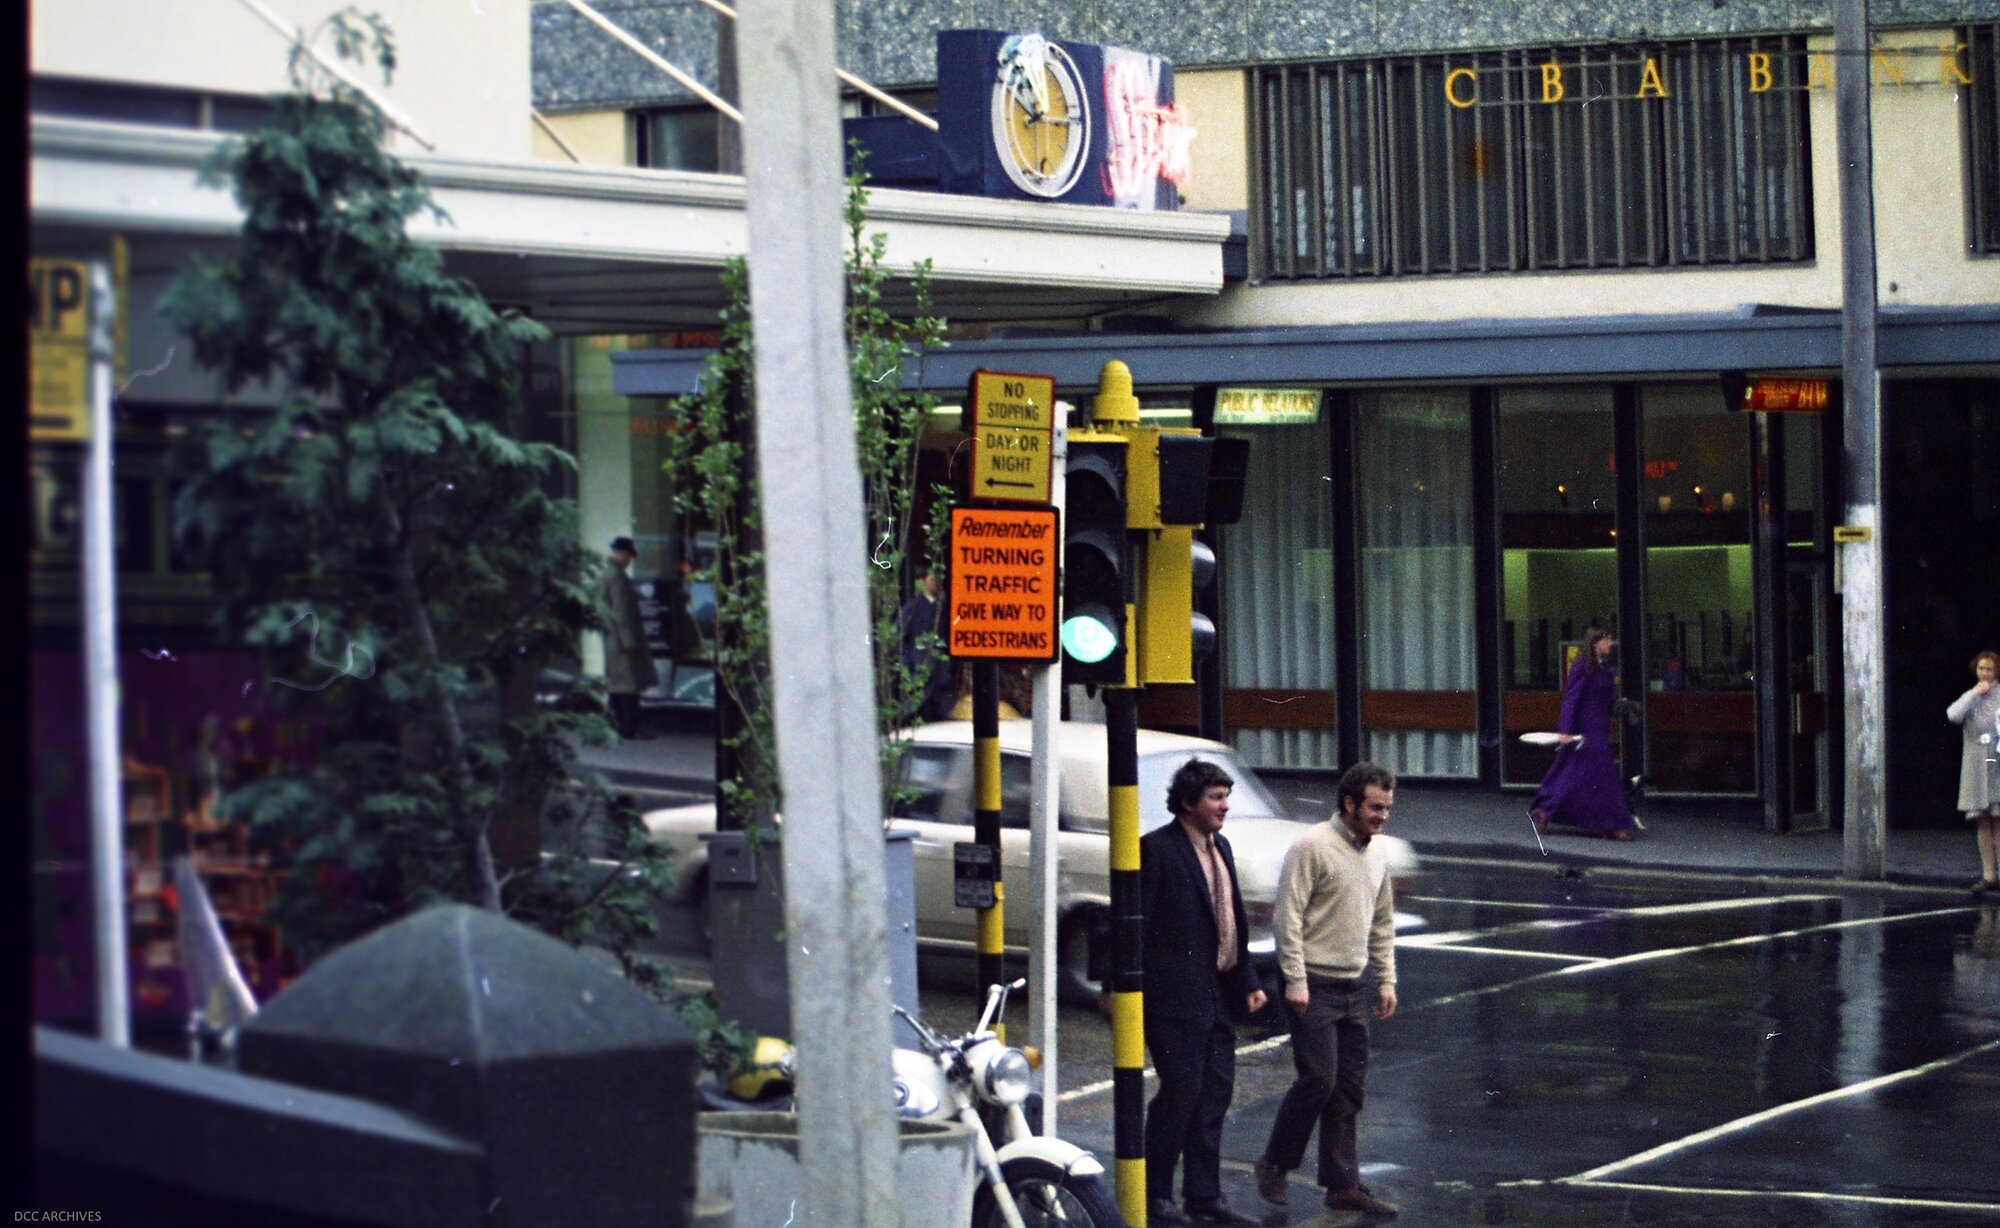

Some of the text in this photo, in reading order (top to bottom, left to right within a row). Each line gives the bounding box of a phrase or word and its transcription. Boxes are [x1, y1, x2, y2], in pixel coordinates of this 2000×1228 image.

[1749, 42, 1974, 93] BANK
[1004, 382, 1024, 399] NO
[1221, 391, 1317, 413] PUBLIC RELATIONS
[987, 402, 1039, 422] STOPPING
[986, 433, 1039, 452] DAY OR
[992, 455, 1031, 472] NIGHT
[959, 517, 1050, 539] Remember
[961, 547, 1044, 566] TURNING
[965, 575, 1041, 594] TRAFFIC
[957, 603, 1046, 622] GIVE WAY TO
[955, 630, 1048, 650] PEDESTRIANS
